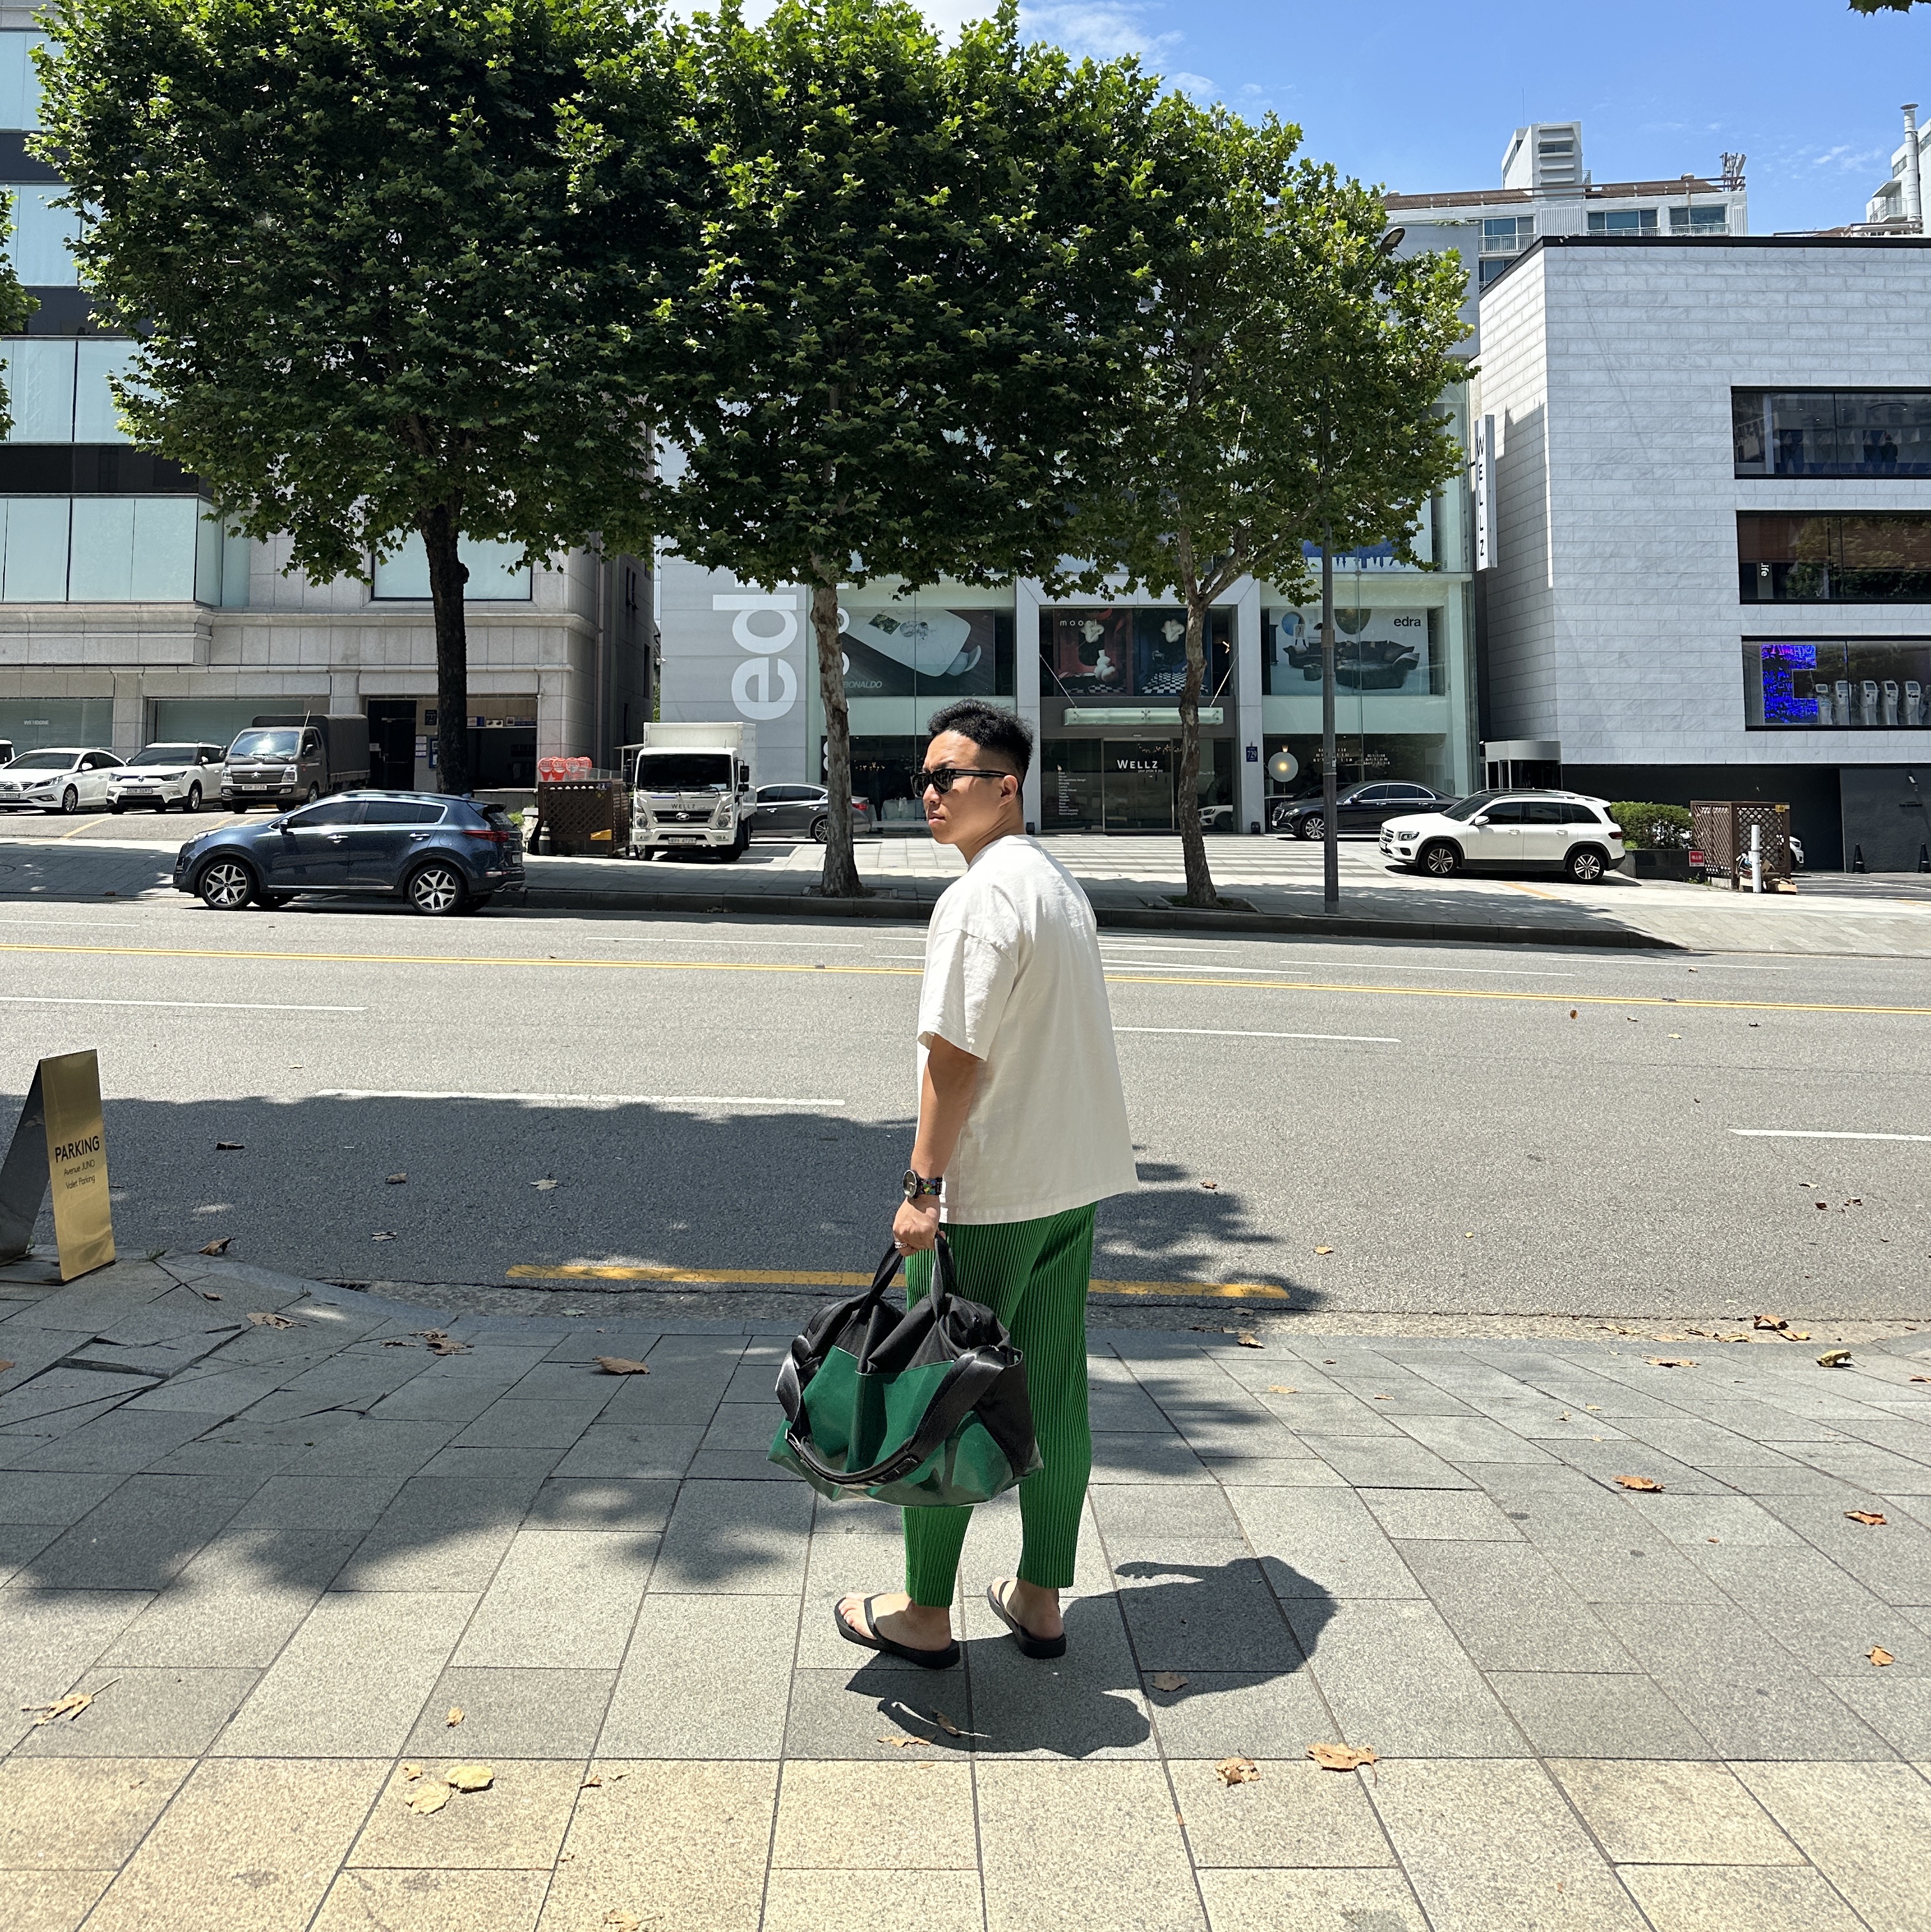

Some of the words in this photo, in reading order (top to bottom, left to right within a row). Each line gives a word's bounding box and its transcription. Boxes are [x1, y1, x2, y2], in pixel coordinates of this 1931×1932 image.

[1476, 434, 1485, 557] WELLZ
[1393, 616, 1421, 627] edra
[843, 680, 883, 689] BONALDO
[1247, 750, 1257, 759] 729
[1117, 759, 1158, 769] WELLZ
[55, 1135, 100, 1163] PARKING
[63, 1165, 81, 1177] Avenue
[81, 1159, 96, 1171] JUNO
[65, 1179, 79, 1190] Valet
[79, 1175, 96, 1186] Parking
